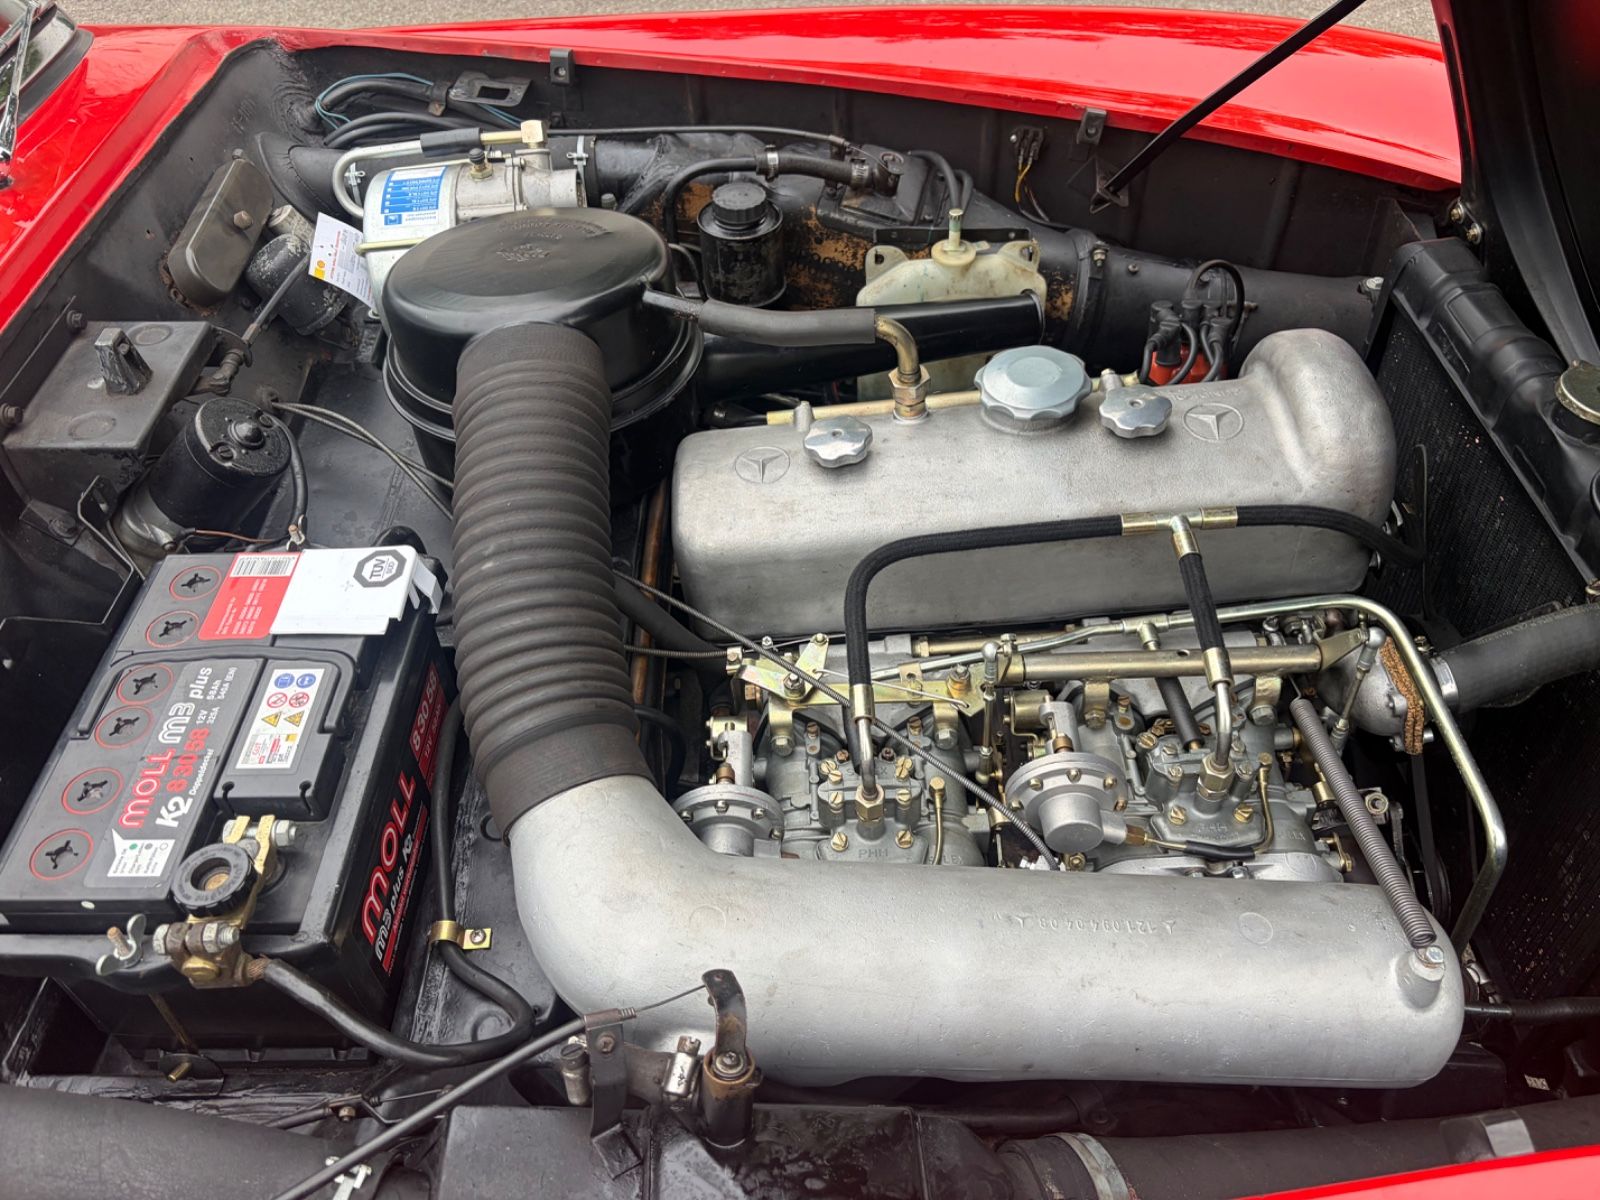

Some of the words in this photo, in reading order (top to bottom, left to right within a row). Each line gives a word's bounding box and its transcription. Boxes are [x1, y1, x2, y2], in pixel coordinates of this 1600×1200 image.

[189, 667, 213, 699] plus
[155, 796, 193, 828] K2
[196, 709, 208, 724] 12V
[390, 866, 405, 915] plus
